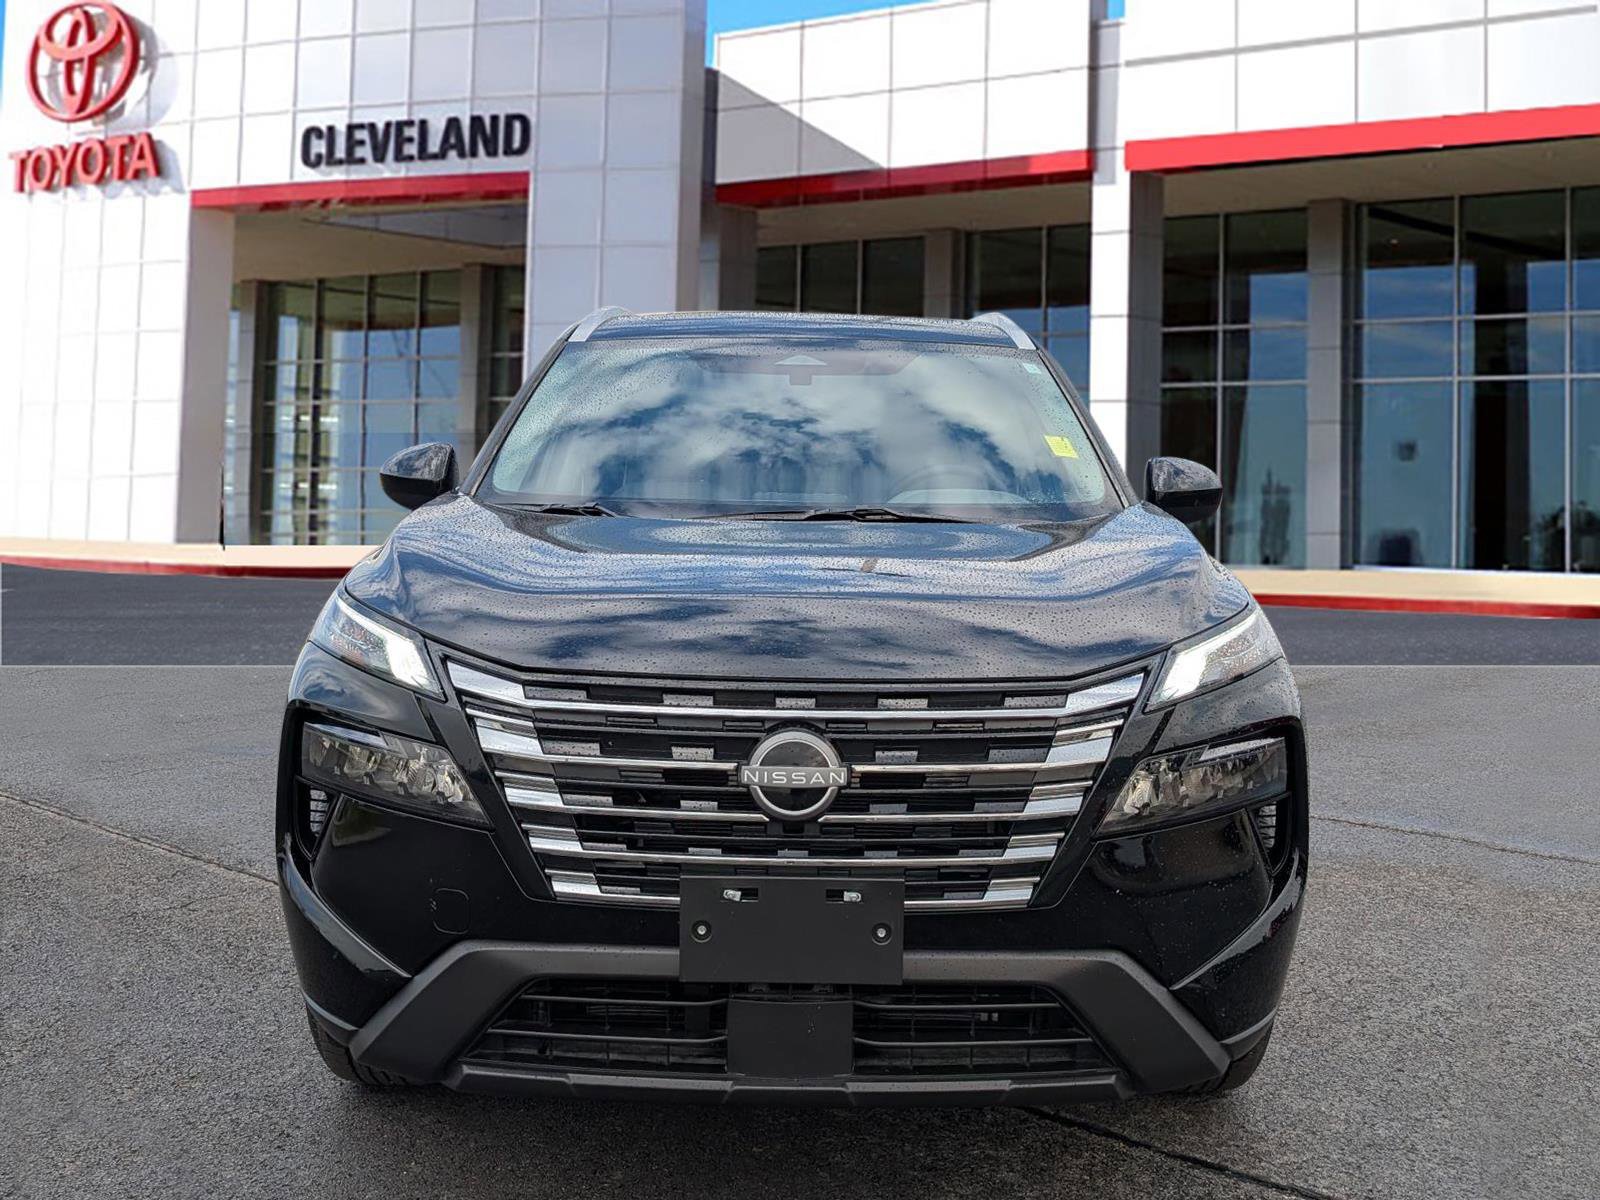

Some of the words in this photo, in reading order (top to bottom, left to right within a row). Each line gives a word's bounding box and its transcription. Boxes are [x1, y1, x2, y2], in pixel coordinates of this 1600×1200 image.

[9, 132, 161, 193] TOYOTA
[301, 113, 531, 169] CLEVELAND
[743, 769, 846, 785] NISSAN
